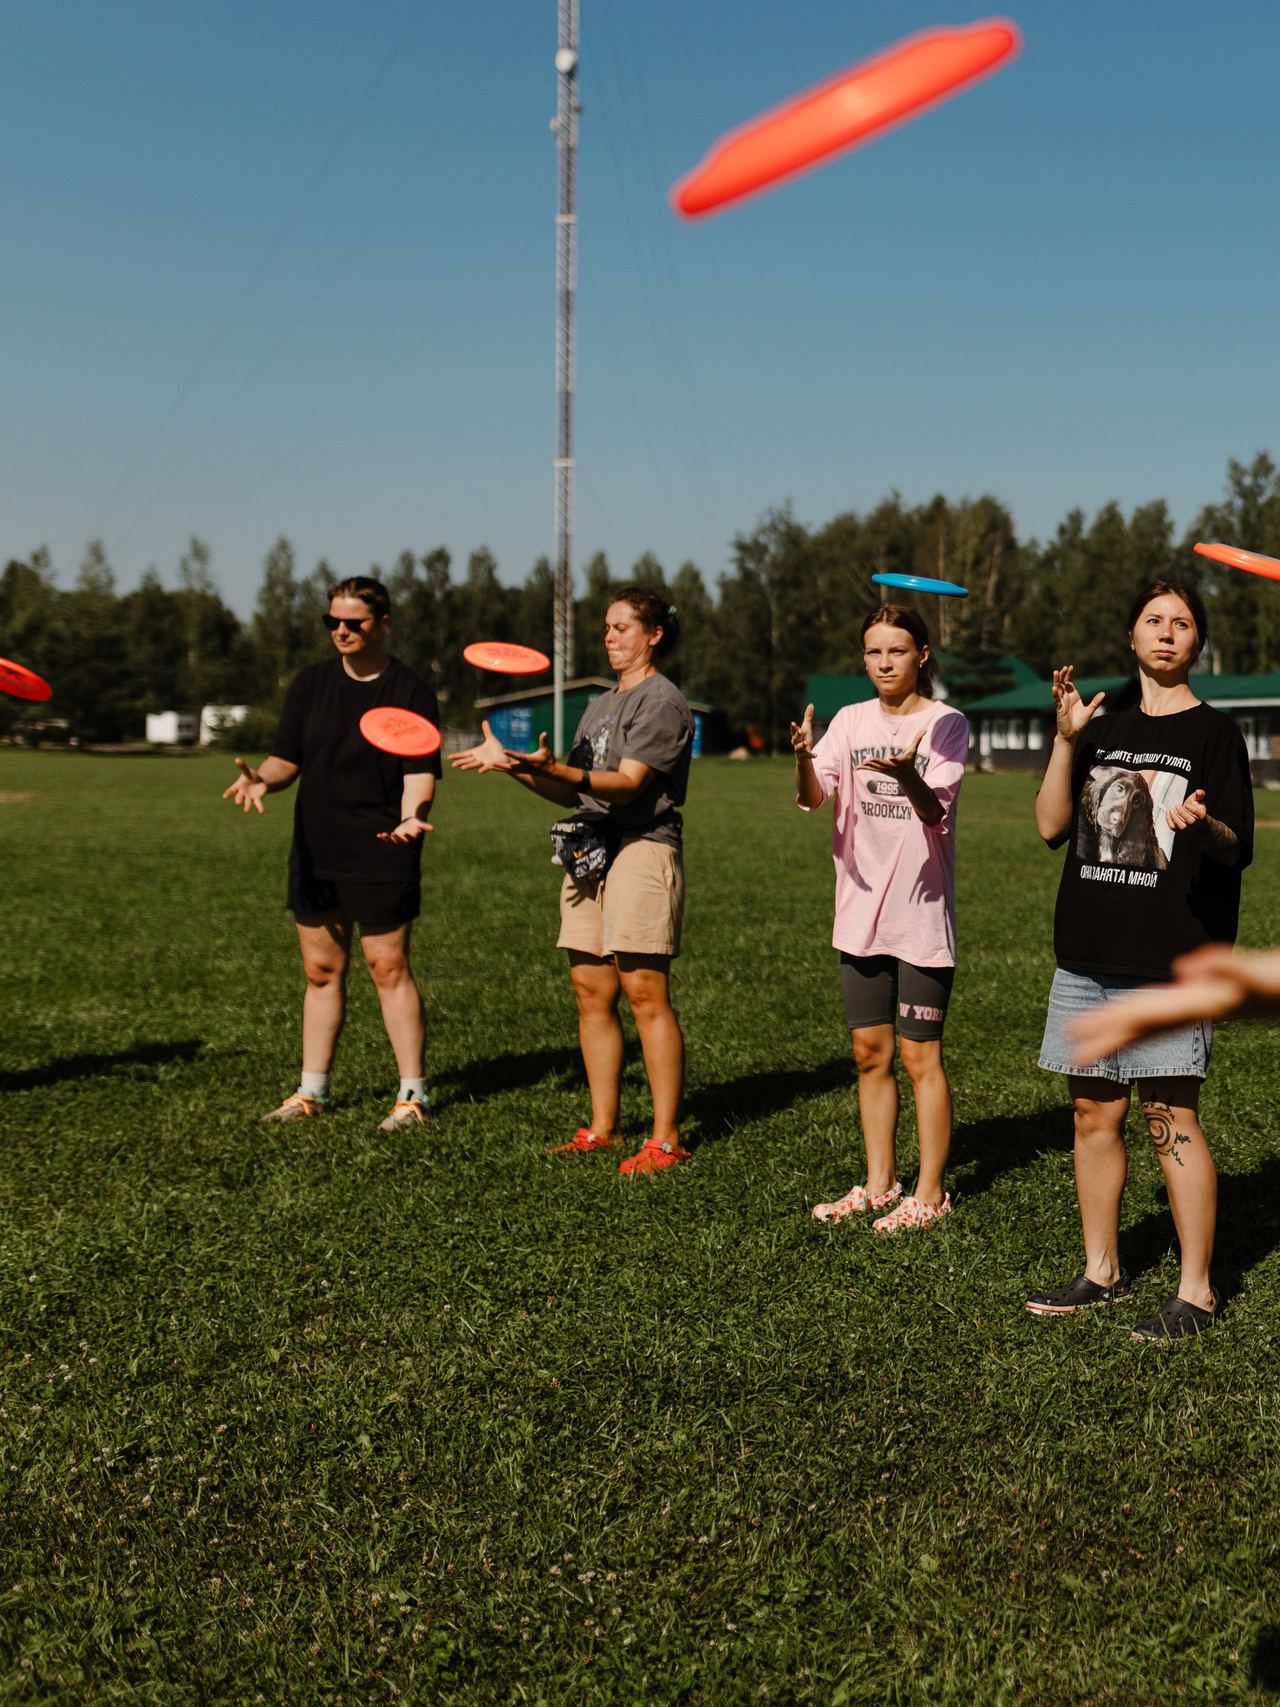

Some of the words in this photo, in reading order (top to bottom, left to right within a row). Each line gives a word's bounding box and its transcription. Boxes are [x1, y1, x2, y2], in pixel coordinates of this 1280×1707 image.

[1160, 754, 1192, 772] ГУЛЯТЬ
[875, 781, 899, 795] 1995
[861, 801, 913, 821] BROOKLYN
[1127, 871, 1158, 888] МНОЙ
